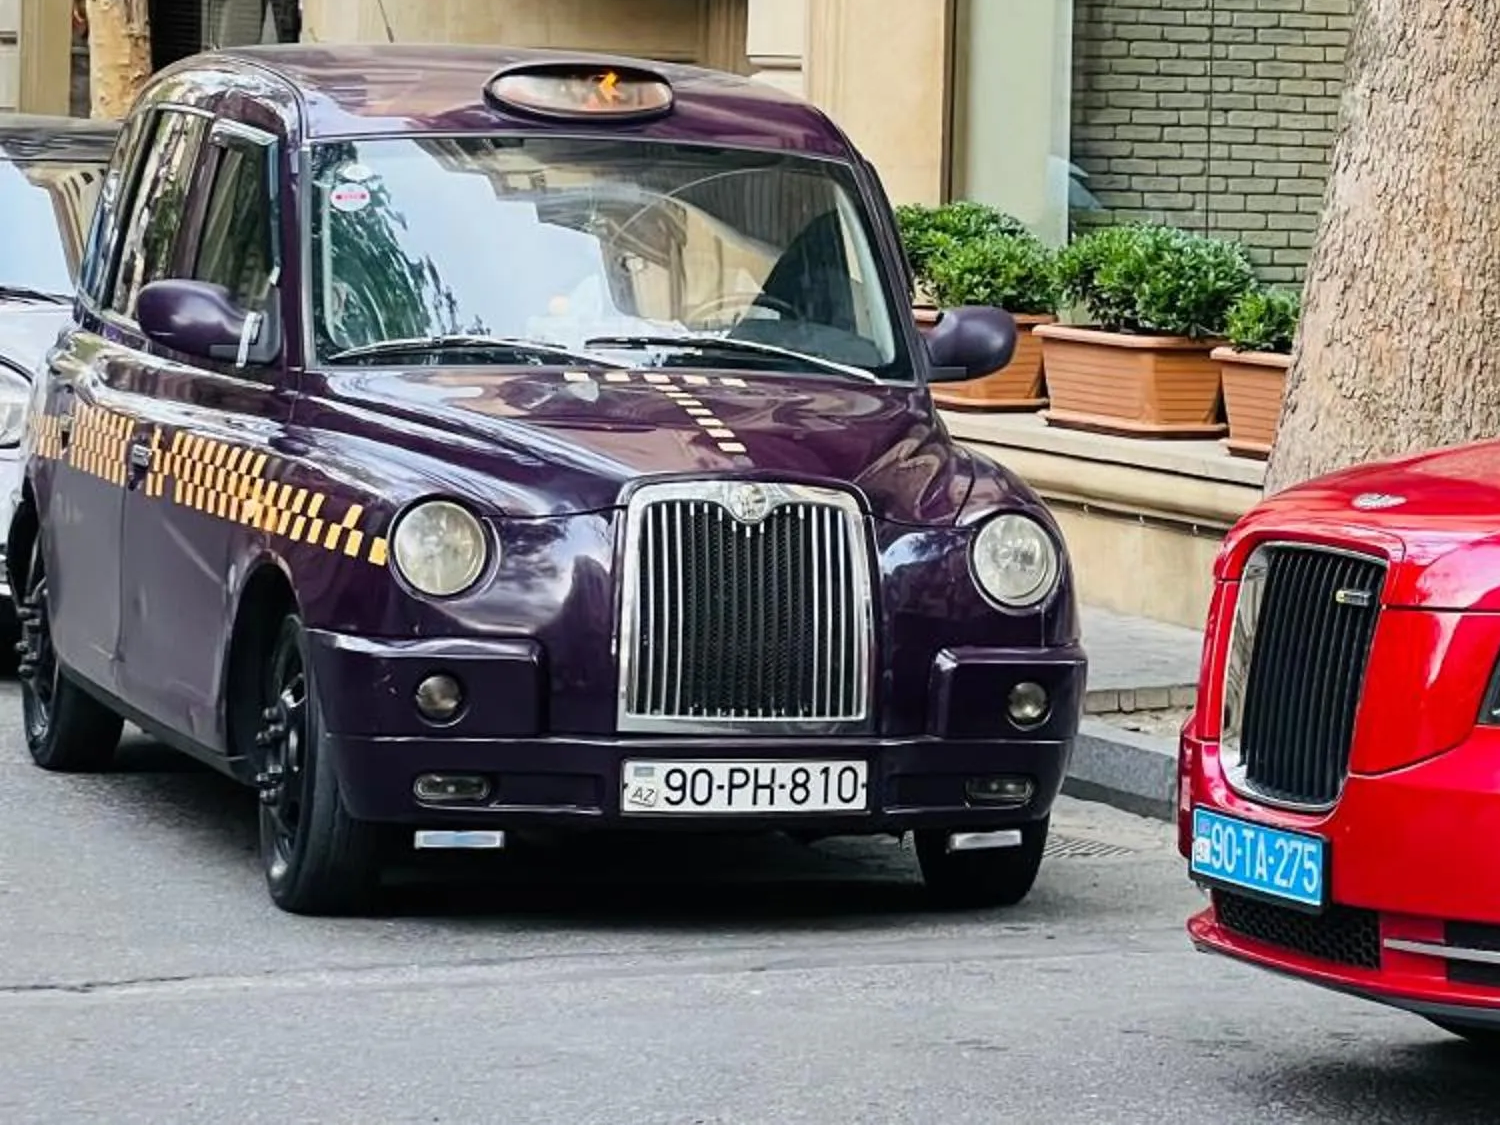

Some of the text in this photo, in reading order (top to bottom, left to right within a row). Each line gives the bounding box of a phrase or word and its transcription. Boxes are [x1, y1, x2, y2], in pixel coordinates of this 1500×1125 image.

[632, 766, 858, 806] AZ 90-PH-810
[1211, 822, 1319, 893] 90-TA-275
